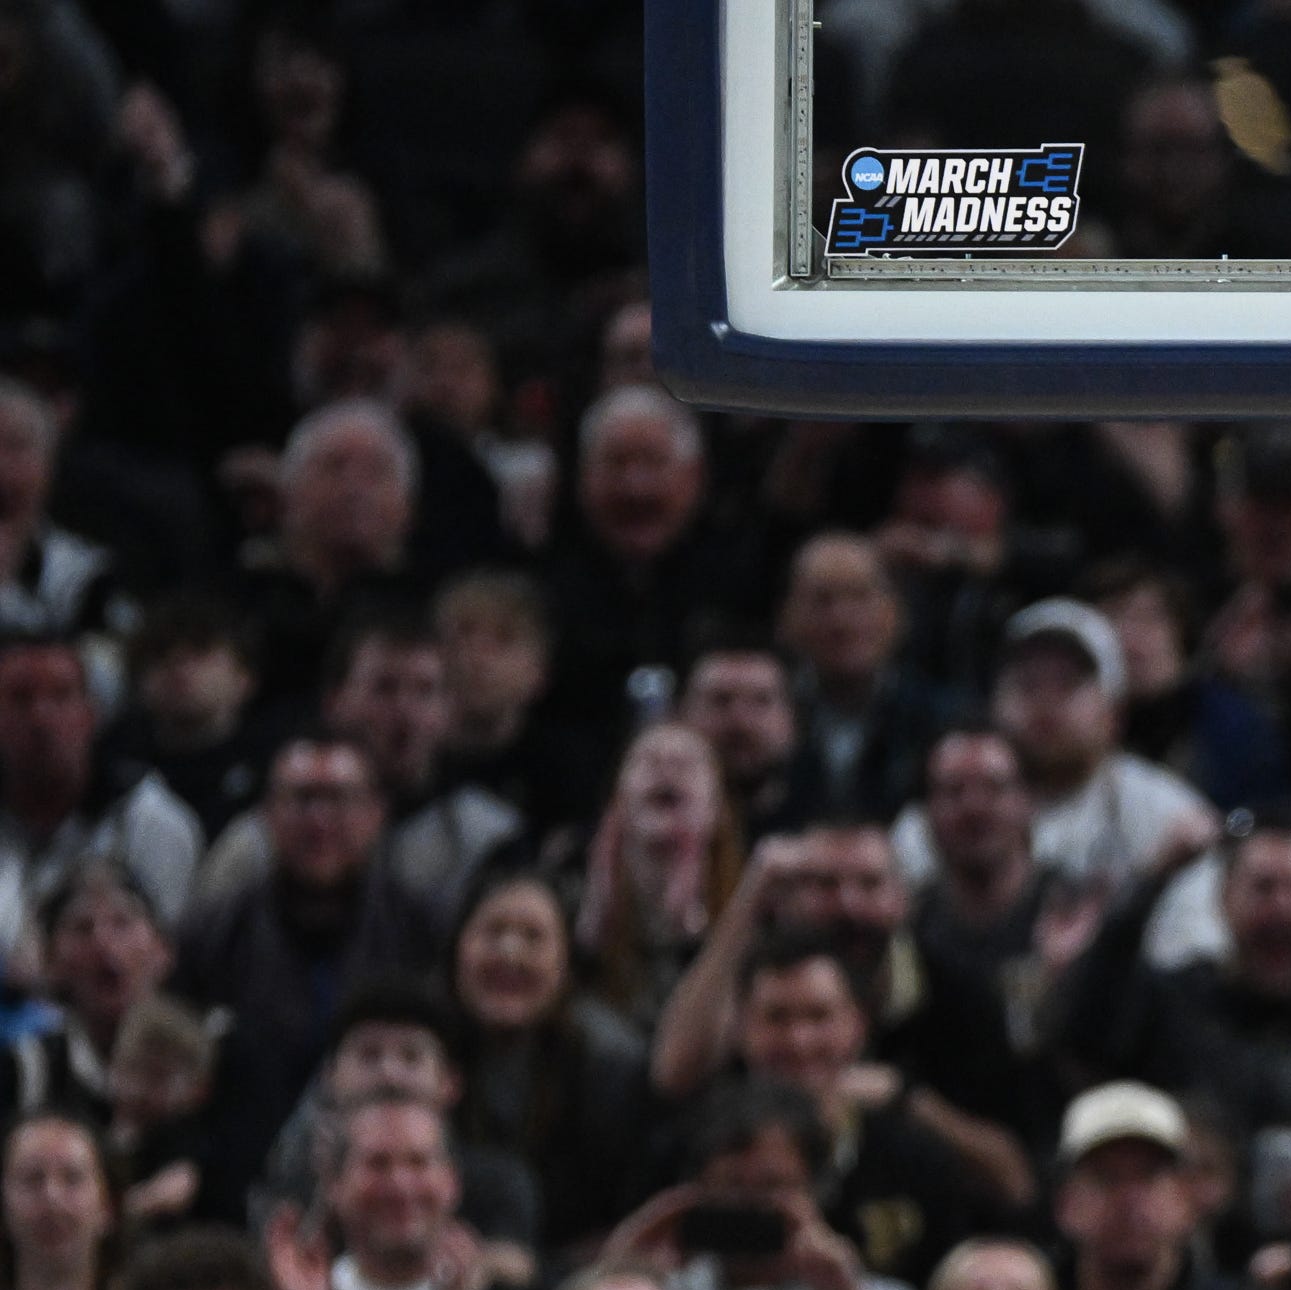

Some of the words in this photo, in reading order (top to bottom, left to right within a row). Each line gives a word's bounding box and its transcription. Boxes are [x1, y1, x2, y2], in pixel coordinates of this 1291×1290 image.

[854, 172, 884, 183] NCAA
[886, 158, 1014, 194] MARCH
[901, 197, 1072, 232] MADNESS
